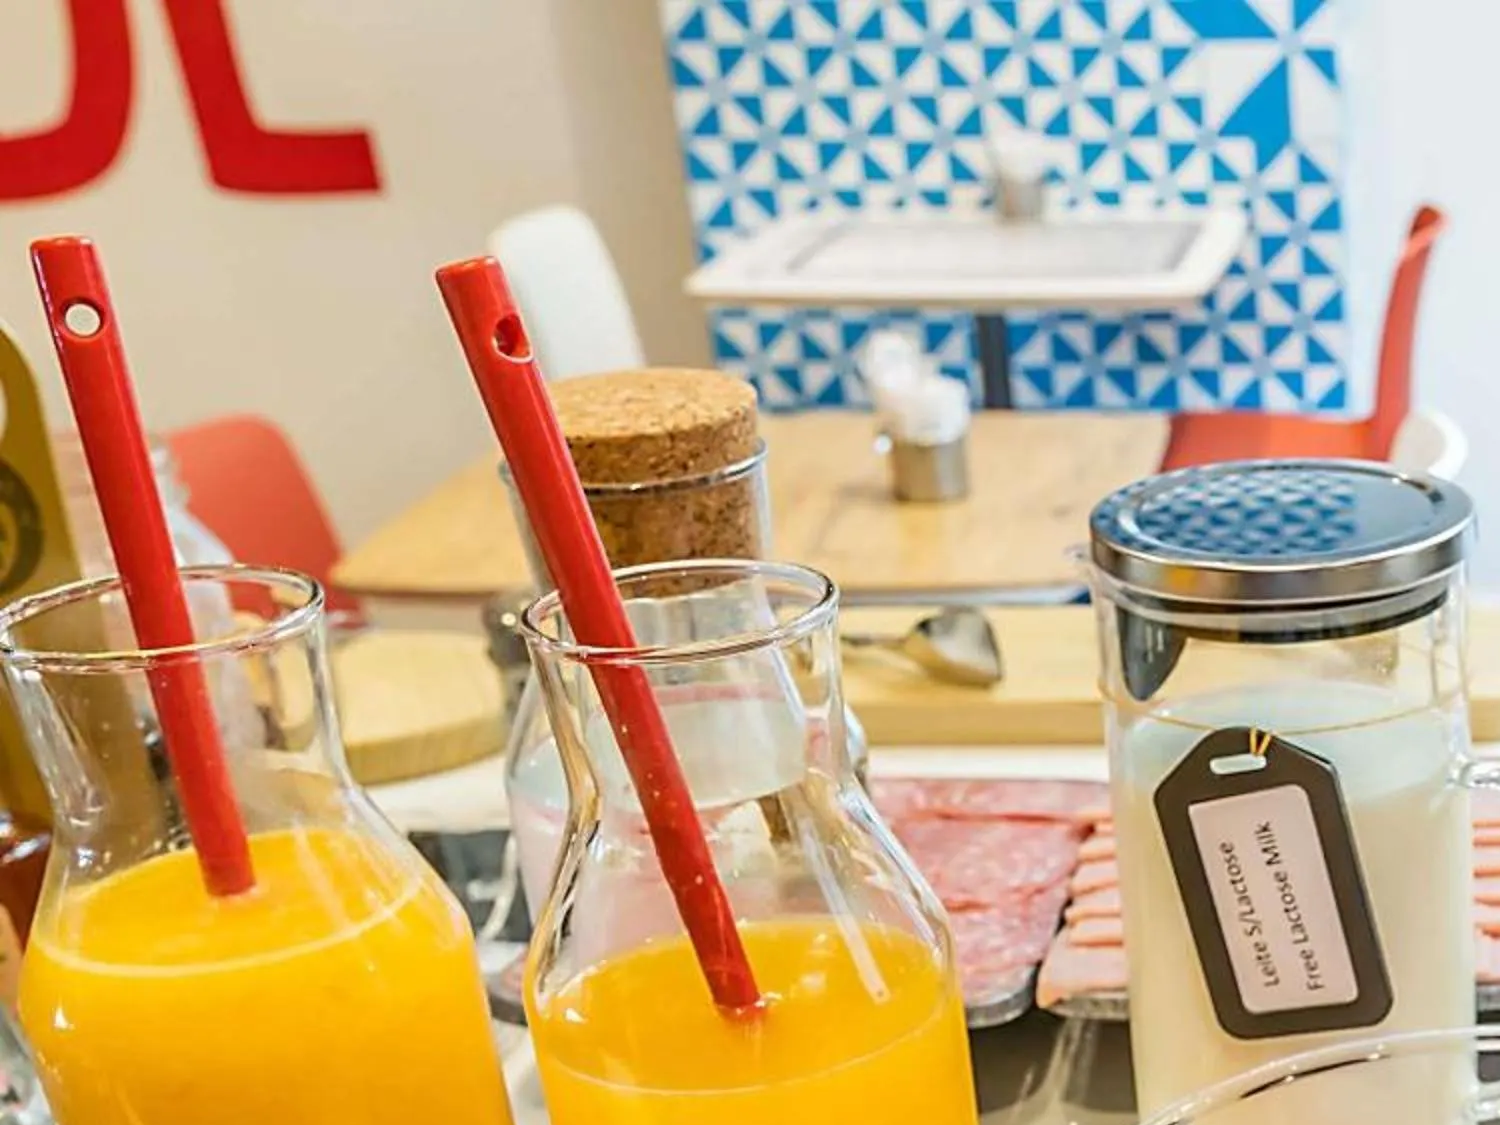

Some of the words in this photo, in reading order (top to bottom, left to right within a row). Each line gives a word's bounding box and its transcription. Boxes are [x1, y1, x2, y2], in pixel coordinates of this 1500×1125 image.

[1254, 821, 1282, 867] Milk
[1220, 842, 1263, 938] S/Lactose
[1273, 871, 1310, 945] Lactose
[1254, 940, 1280, 988] Leite
[1300, 948, 1325, 991] Free
